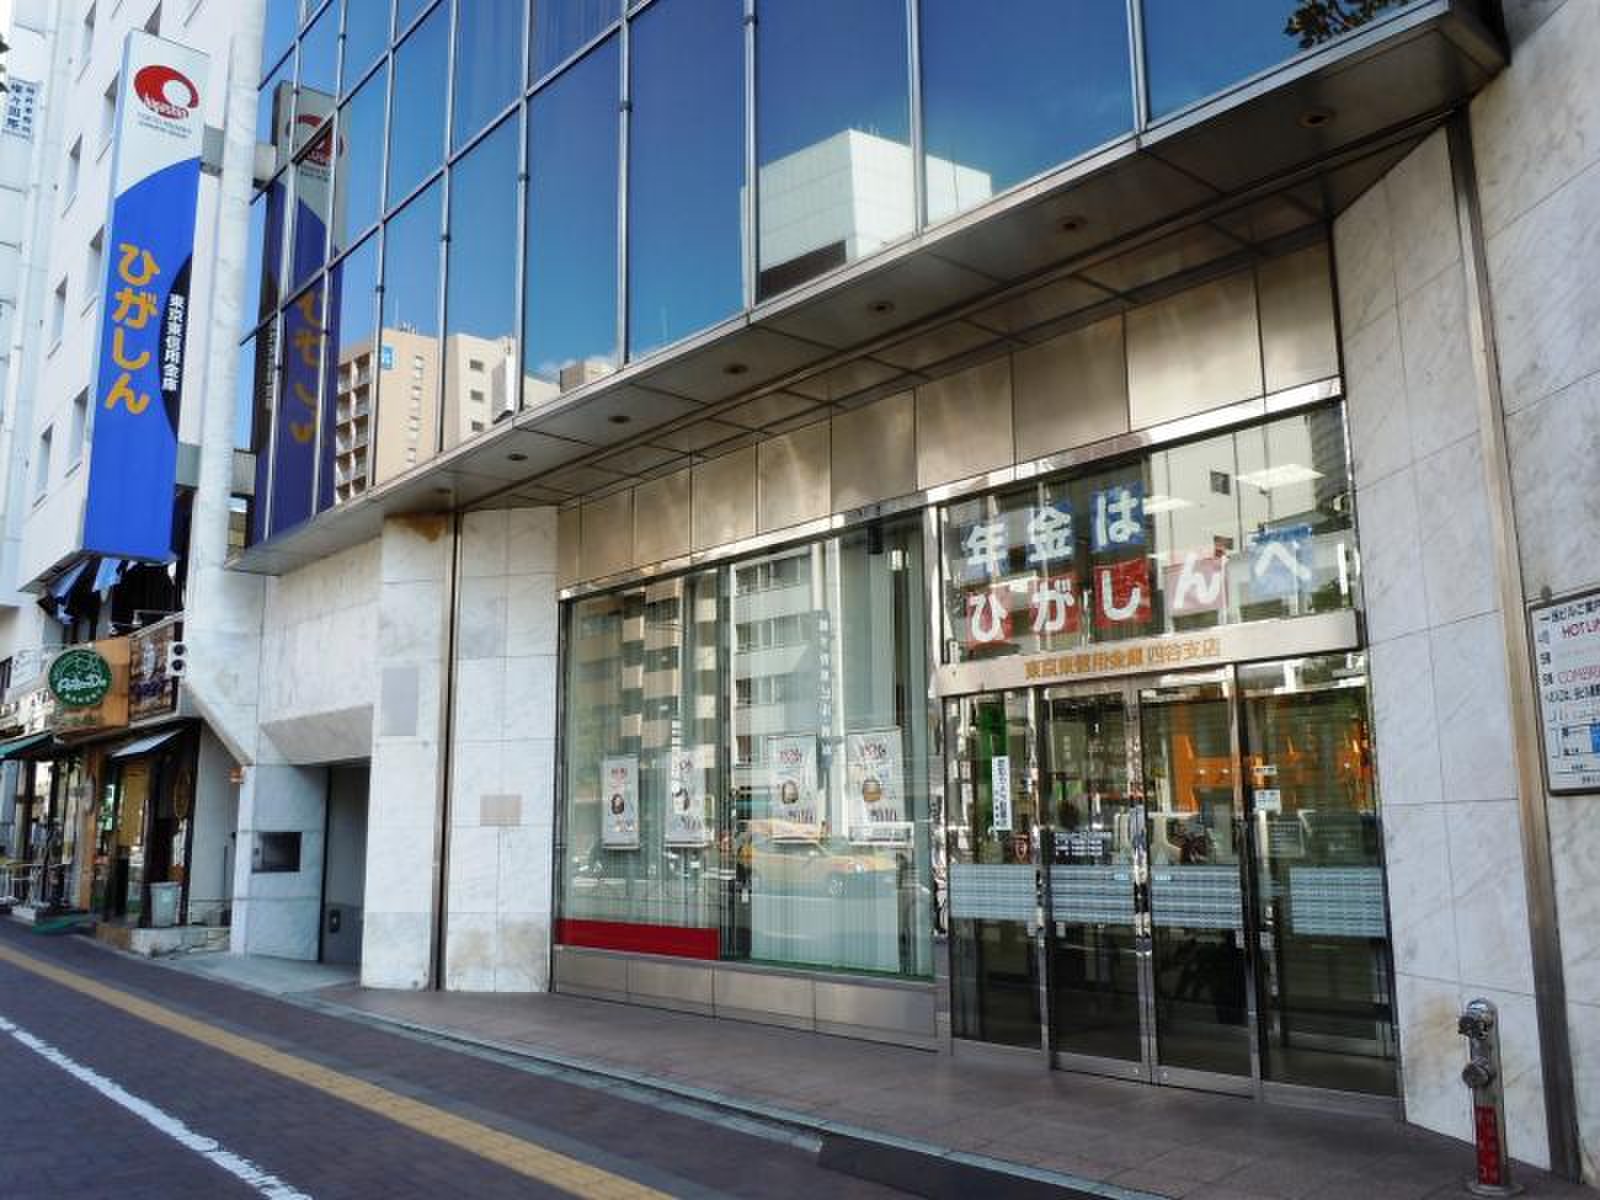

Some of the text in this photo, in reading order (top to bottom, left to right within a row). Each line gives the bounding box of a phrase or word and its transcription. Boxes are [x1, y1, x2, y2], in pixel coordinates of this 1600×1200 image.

[104, 243, 161, 415] ひがしん
[962, 488, 1142, 574] 年金は
[968, 540, 1312, 642] ひがしんへ
